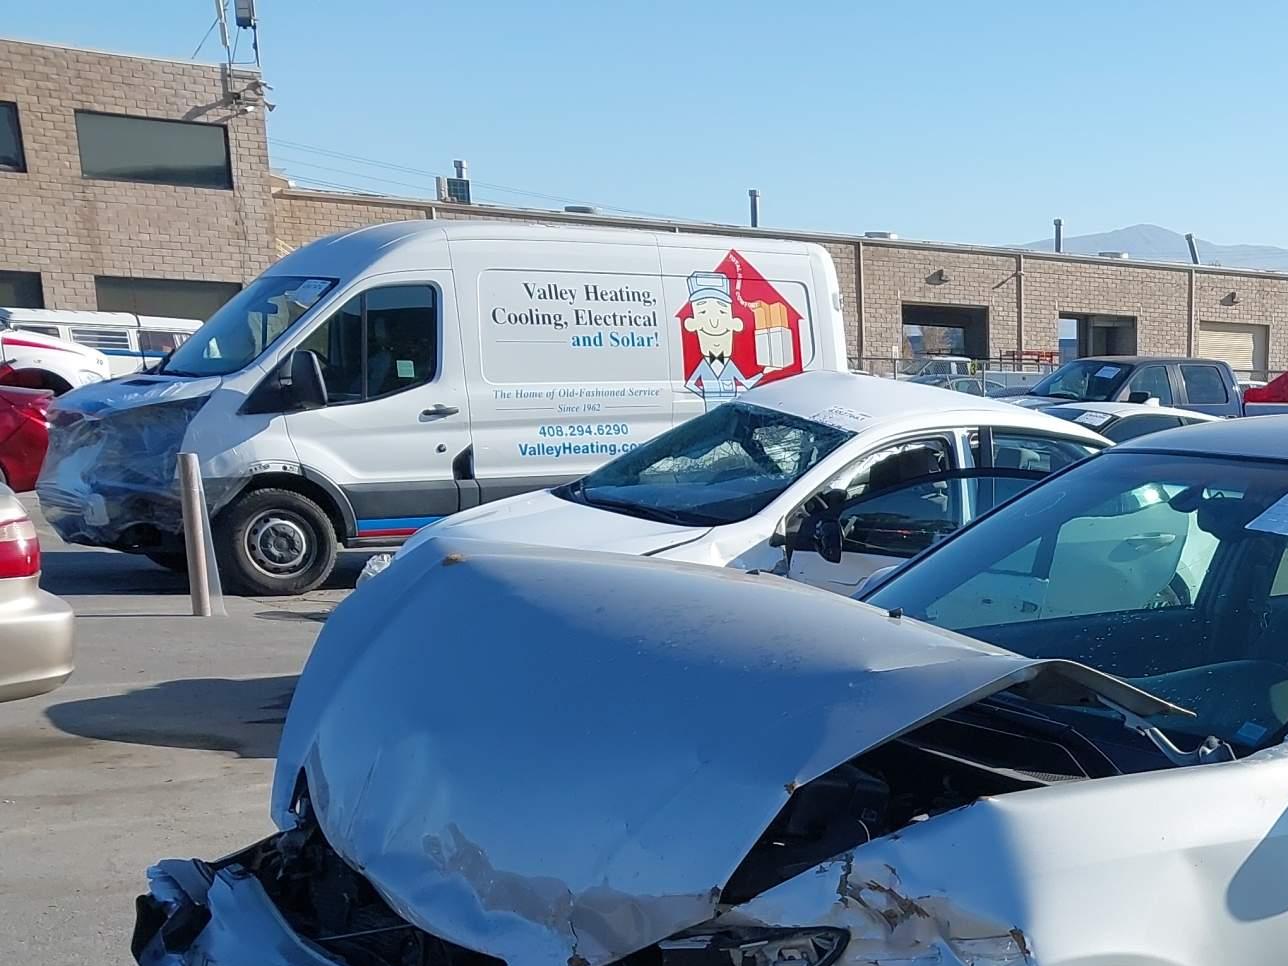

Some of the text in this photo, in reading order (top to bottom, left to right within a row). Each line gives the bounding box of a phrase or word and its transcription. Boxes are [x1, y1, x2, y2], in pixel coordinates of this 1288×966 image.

[522, 282, 657, 306] Valley Heating,
[491, 306, 658, 329] Cooling, Electrical
[571, 331, 659, 347] and Solar!
[494, 387, 660, 400] The Home of Old-Fashioned Service
[557, 404, 601, 413] Since 1962
[539, 424, 628, 437] 408.294.6290
[519, 442, 641, 457] ValleyHeating.co
